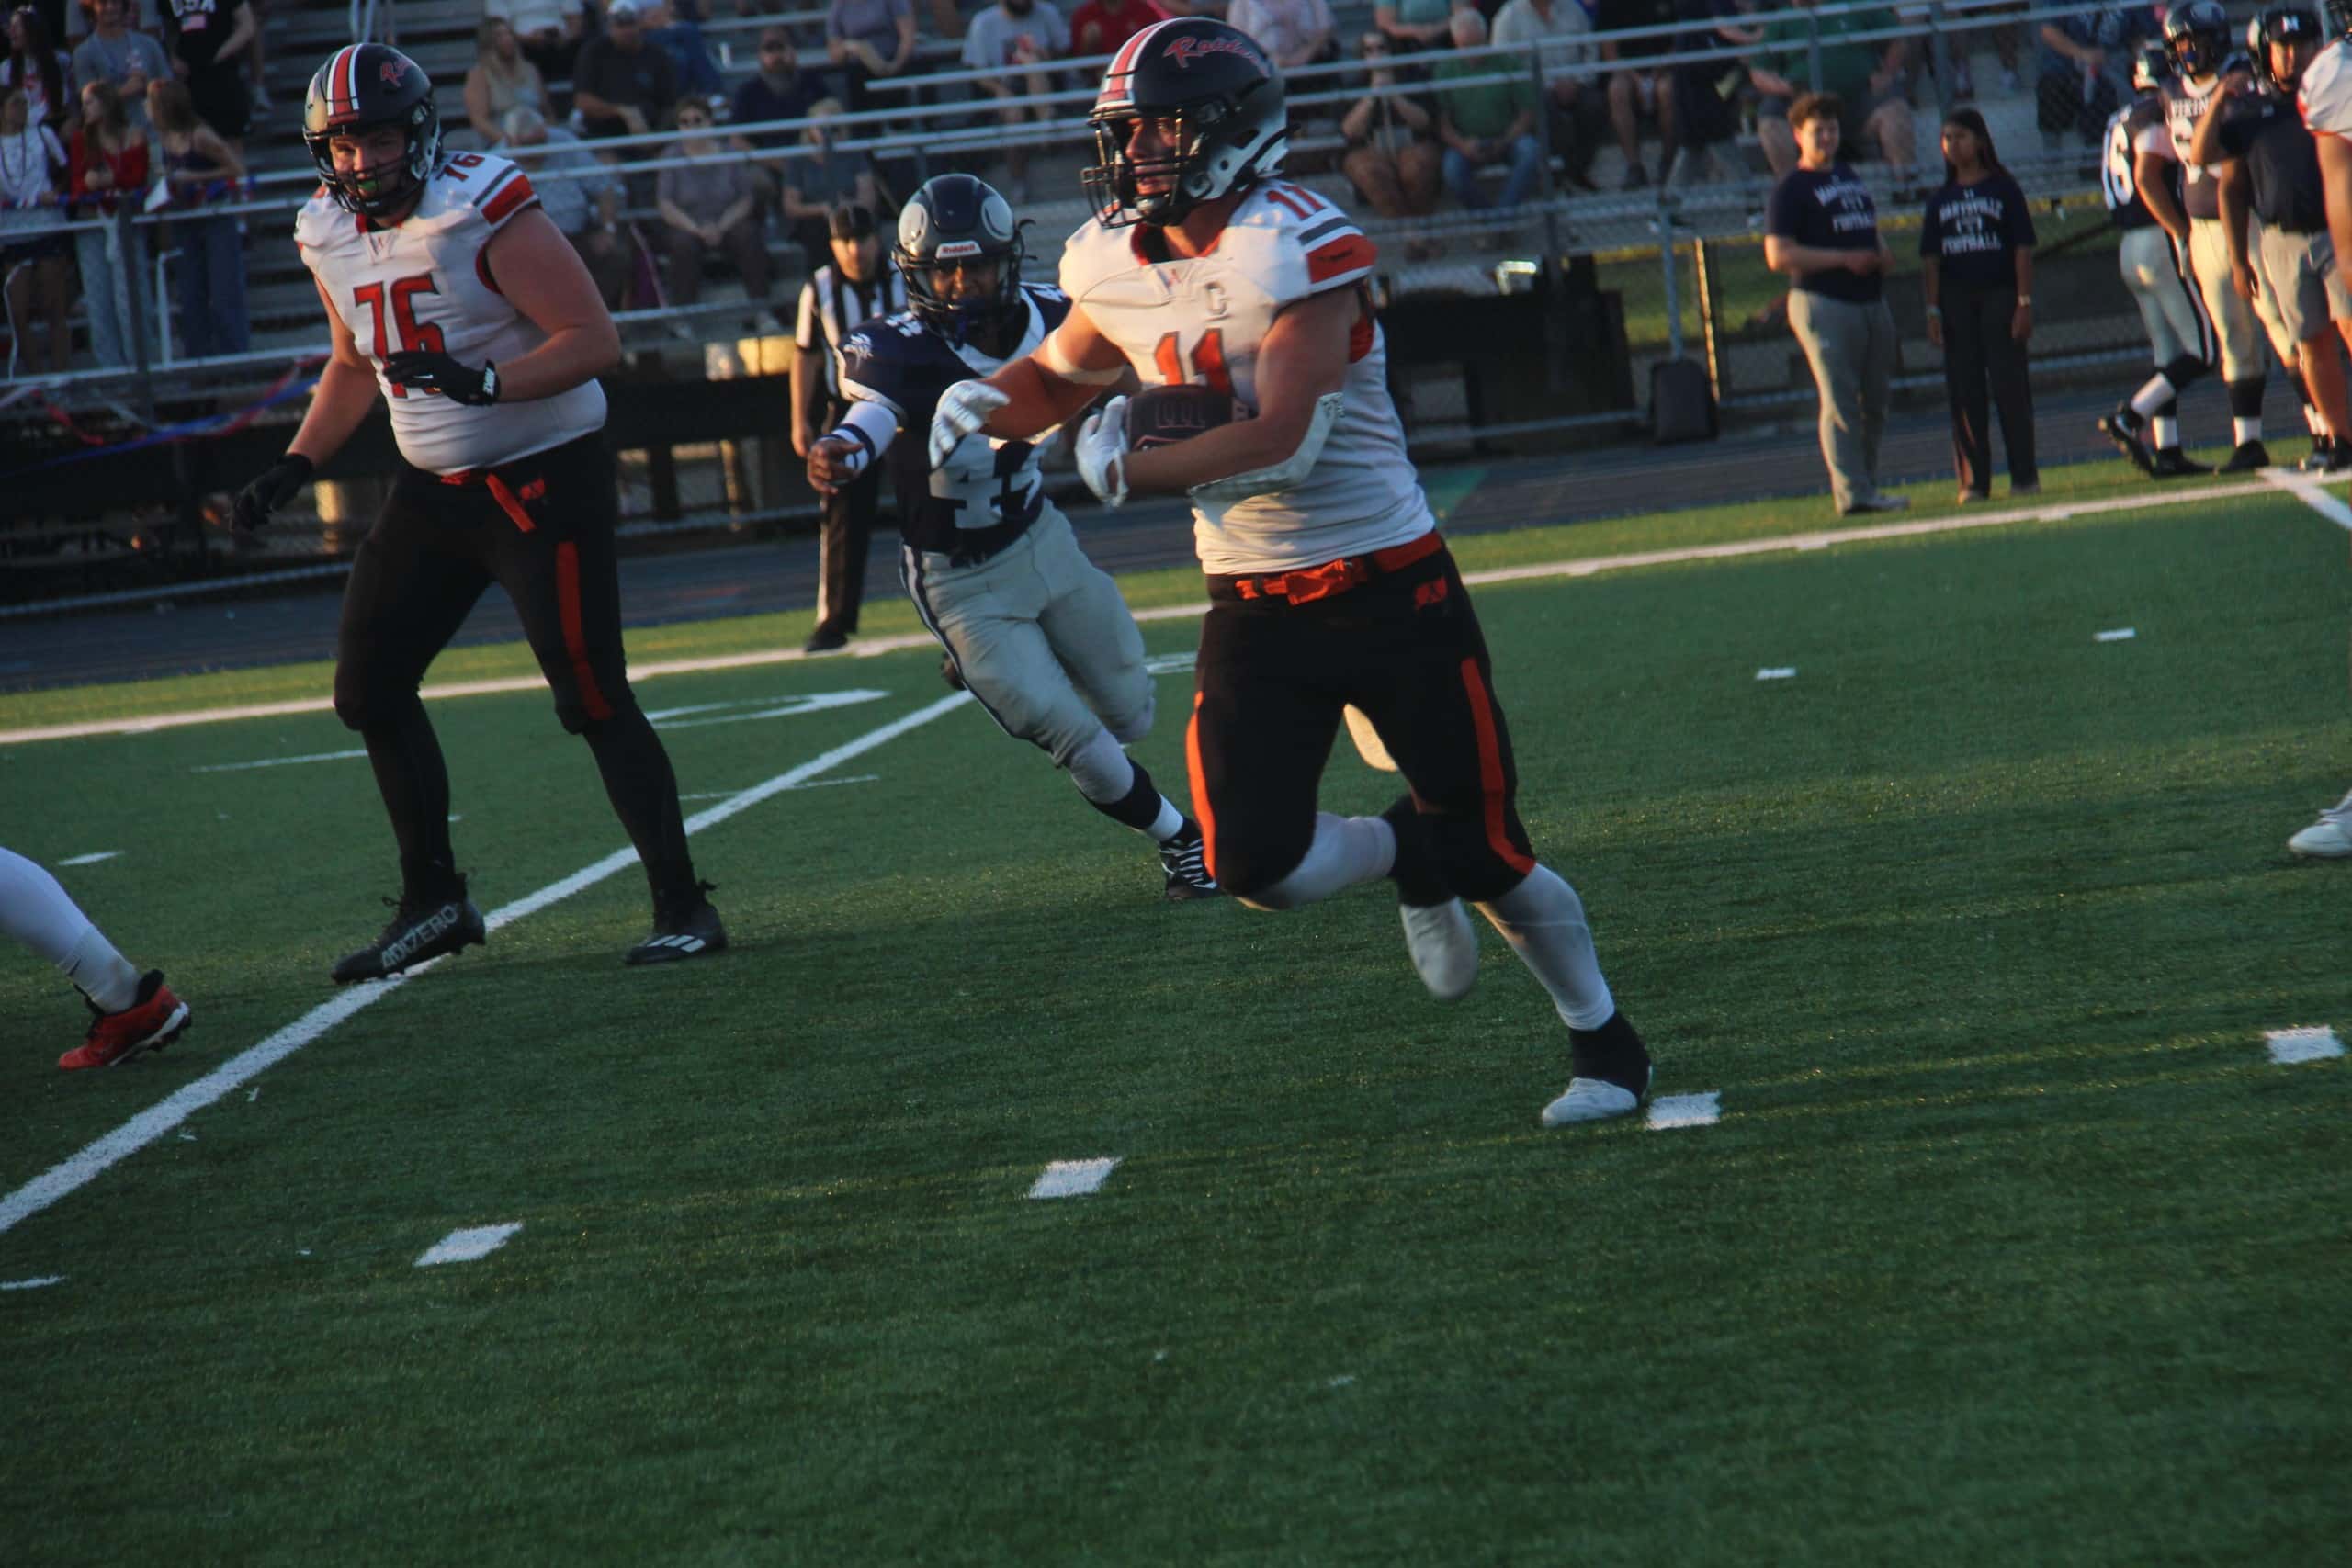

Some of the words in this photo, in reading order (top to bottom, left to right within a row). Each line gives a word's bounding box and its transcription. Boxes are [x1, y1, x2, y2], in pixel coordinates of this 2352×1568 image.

[2282, 15, 2301, 34] M
[2170, 95, 2210, 118] VIKIN
[436, 152, 486, 182] 76
[1266, 183, 1326, 221] 11
[941, 243, 977, 254] Riddell
[353, 273, 447, 399] 76
[1154, 327, 1235, 397] 11
